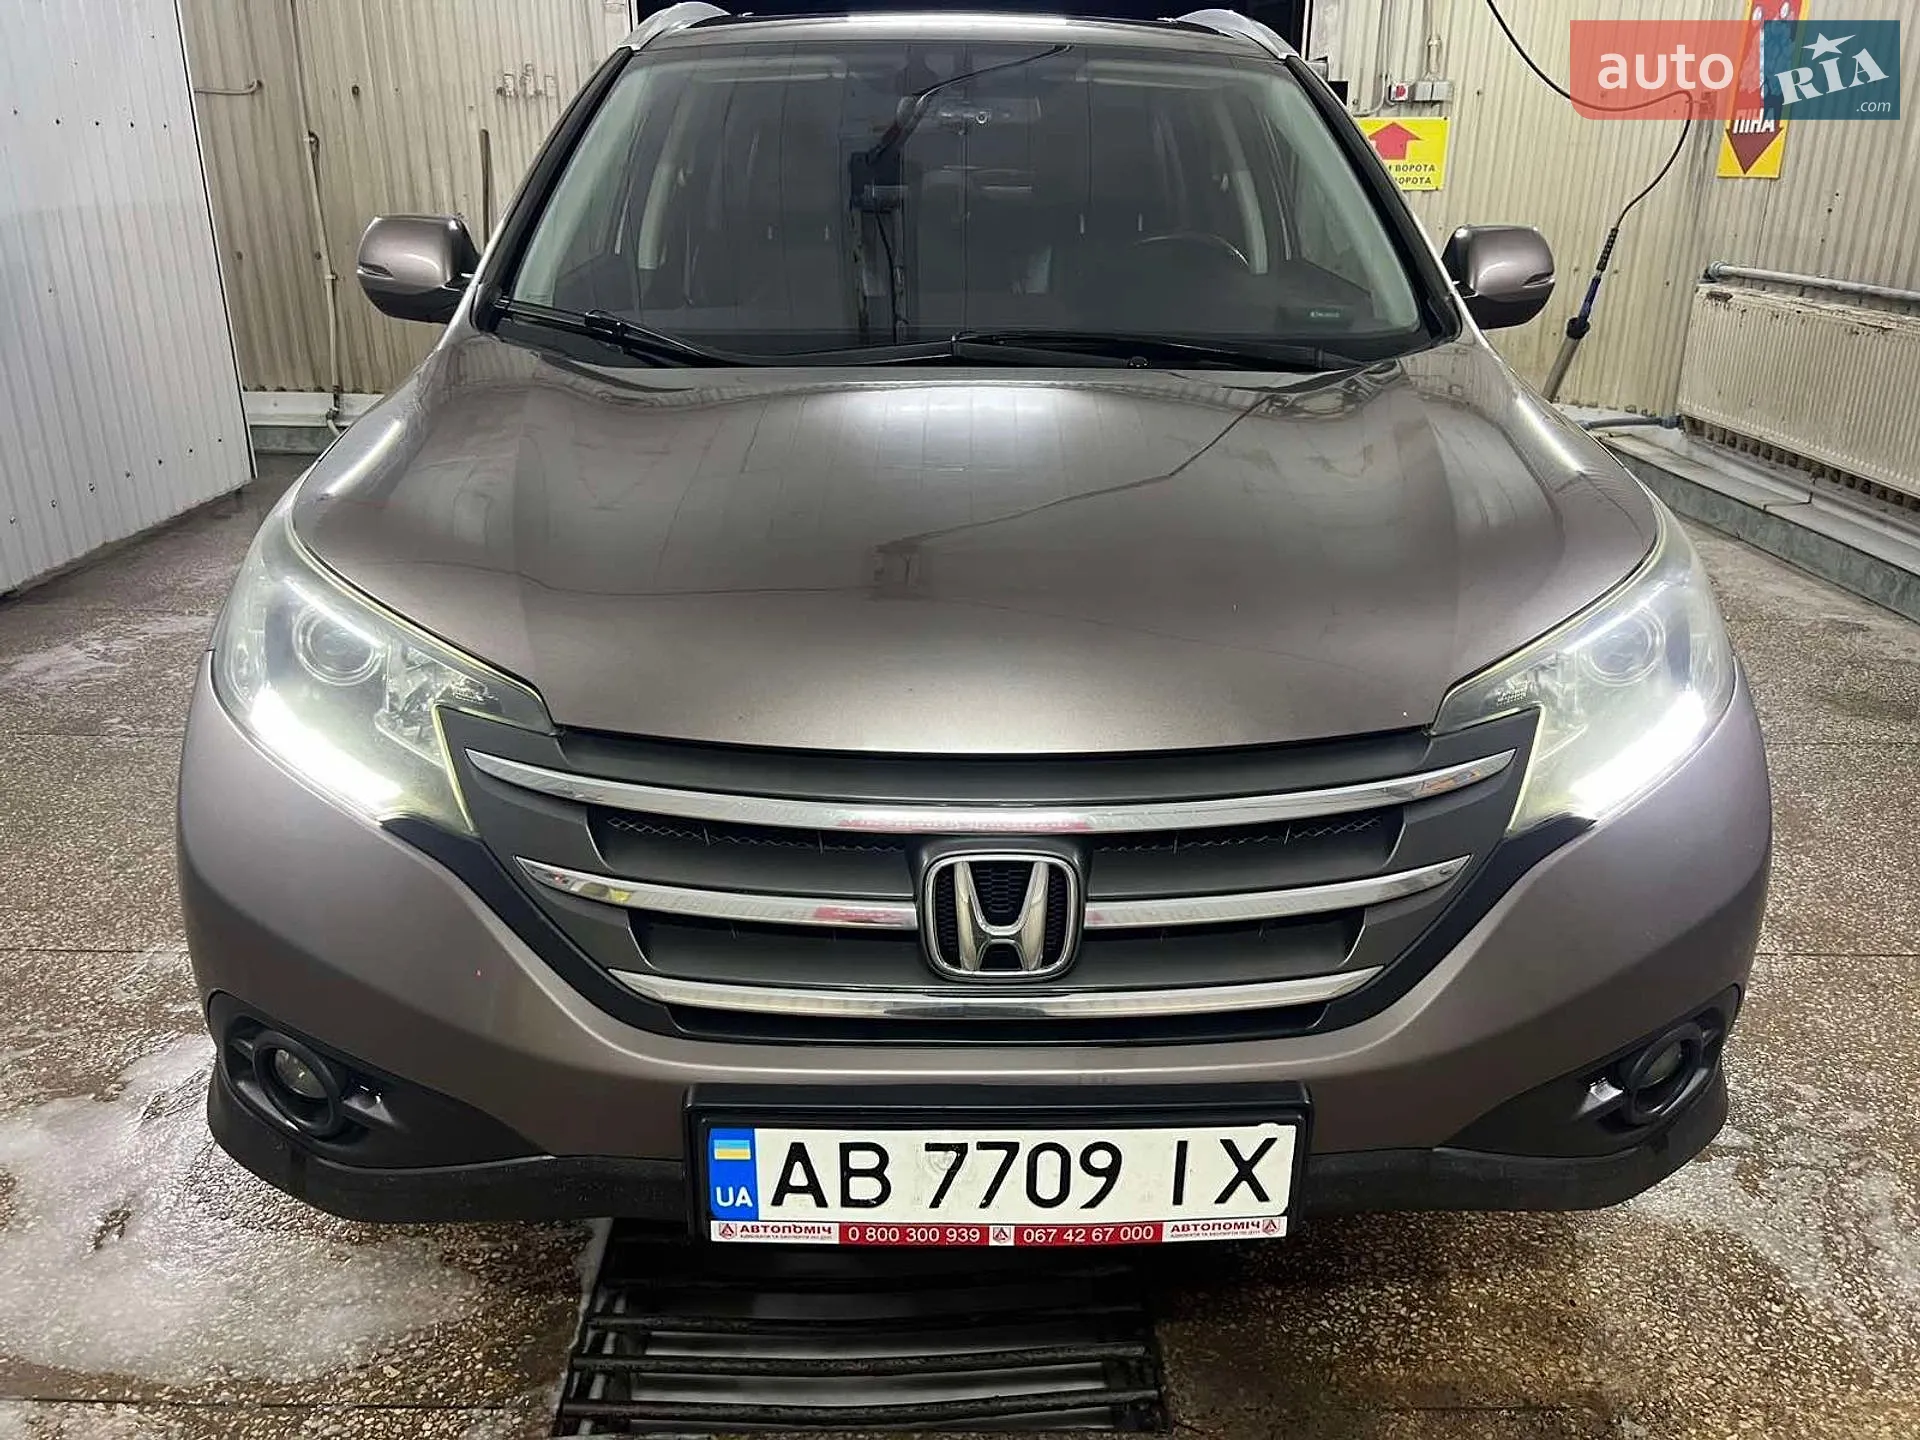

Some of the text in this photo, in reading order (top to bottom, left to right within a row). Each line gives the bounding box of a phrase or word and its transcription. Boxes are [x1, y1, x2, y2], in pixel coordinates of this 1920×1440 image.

[771, 1141, 892, 1208] AB
[924, 1140, 1123, 1209] 7709
[716, 1186, 753, 1208] UA
[848, 1226, 981, 1243] 0 800 300 939
[1023, 1228, 1057, 1243] 067
[1062, 1228, 1087, 1243] 42
[1090, 1227, 1113, 1242] 67
[1119, 1225, 1154, 1241] 000
[1171, 1220, 1260, 1233] АВТОПОМІЧ
